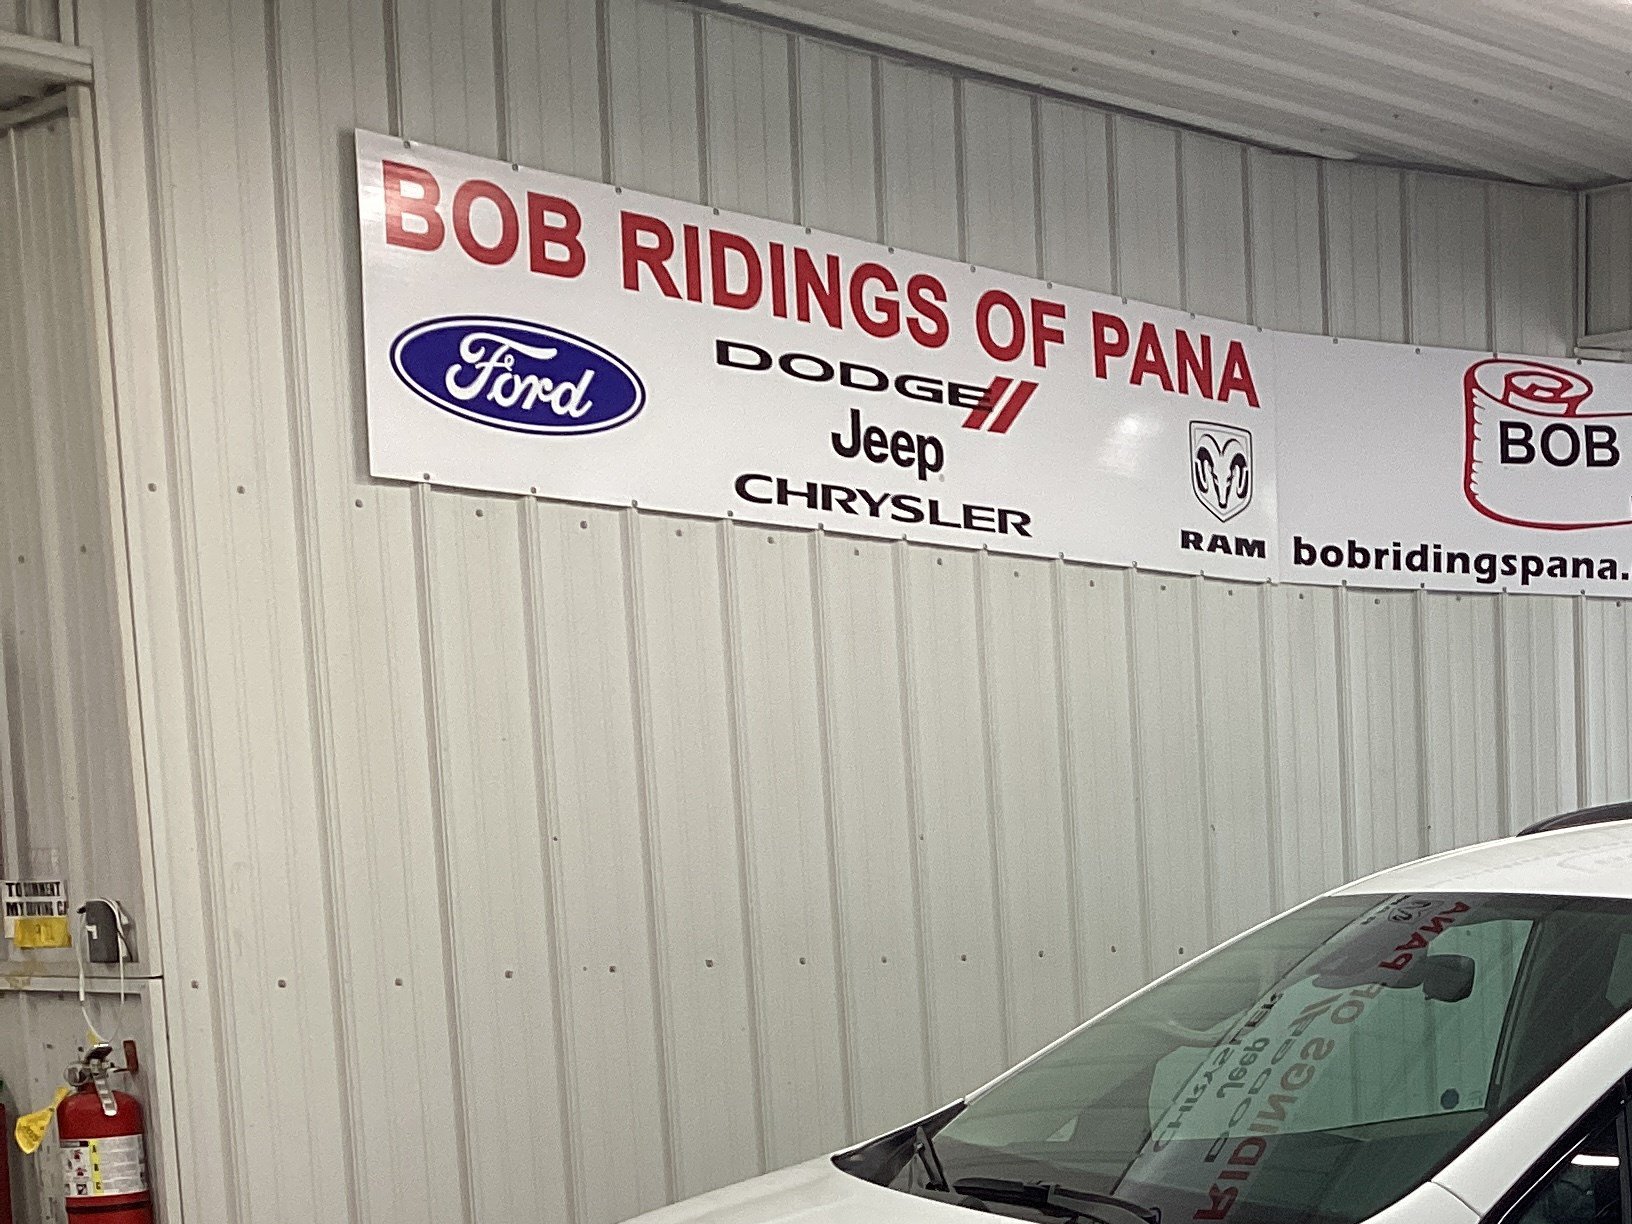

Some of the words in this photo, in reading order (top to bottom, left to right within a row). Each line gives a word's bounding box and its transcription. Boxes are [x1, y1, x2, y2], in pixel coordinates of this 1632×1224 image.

[381, 160, 586, 279] BOB
[621, 211, 950, 348] RIDINGS
[975, 289, 1066, 368] OF
[1090, 311, 1260, 408] PANA
[445, 332, 595, 418] Ford
[715, 339, 993, 410] DODGE
[832, 408, 944, 480] Jeep
[1500, 419, 1620, 468] BOB
[735, 472, 1032, 538] CHRYSLER
[1181, 529, 1267, 559] RAM
